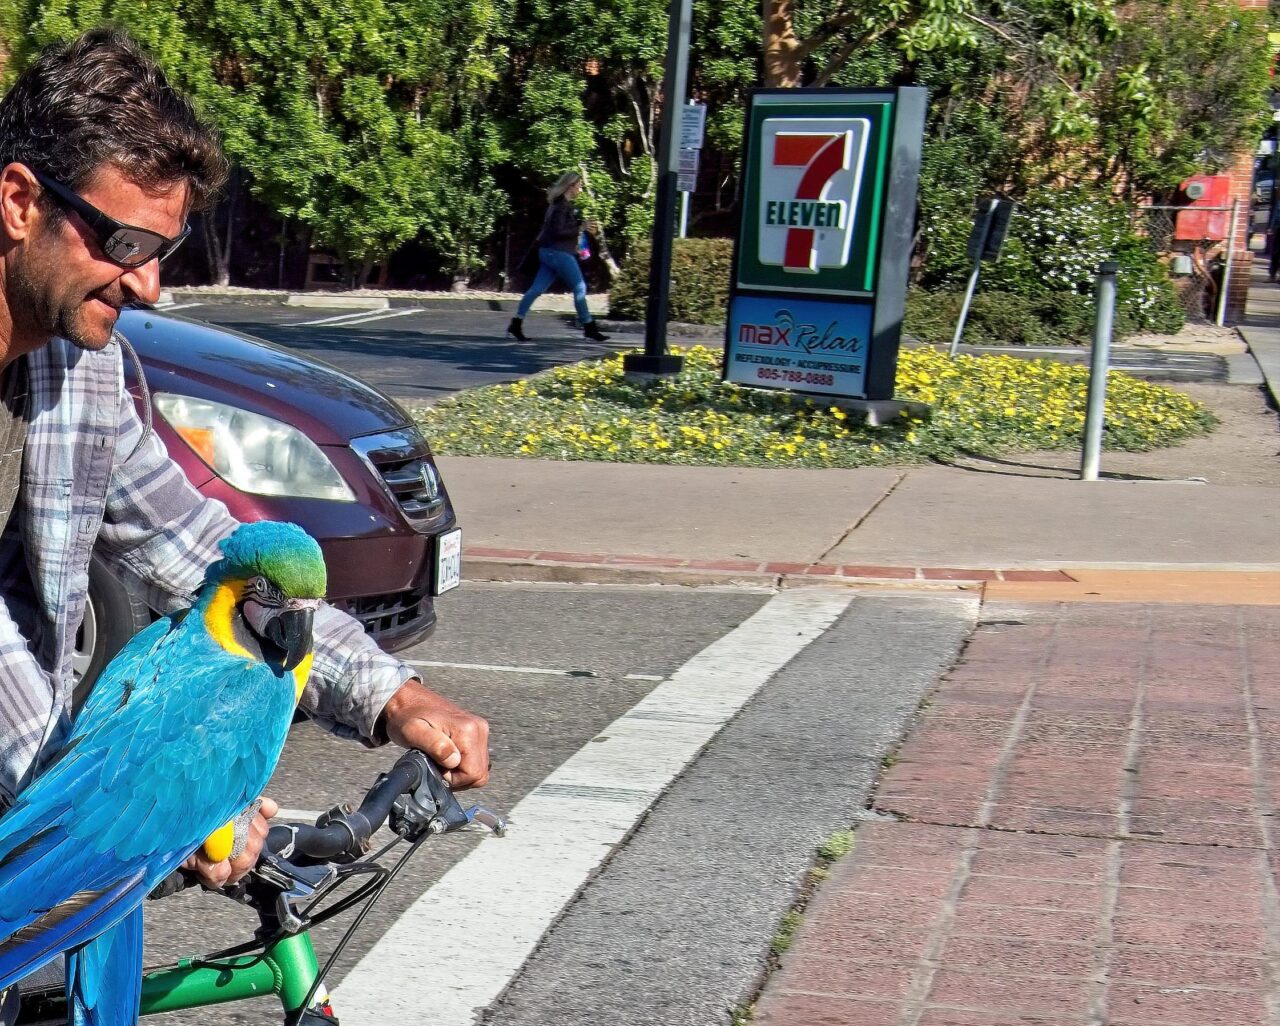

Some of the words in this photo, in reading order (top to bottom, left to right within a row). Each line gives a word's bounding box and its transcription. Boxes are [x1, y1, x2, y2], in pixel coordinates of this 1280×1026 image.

[773, 131, 850, 270] 7
[795, 320, 863, 354] Relax
[735, 352, 792, 367] REFLEXOLOGY
